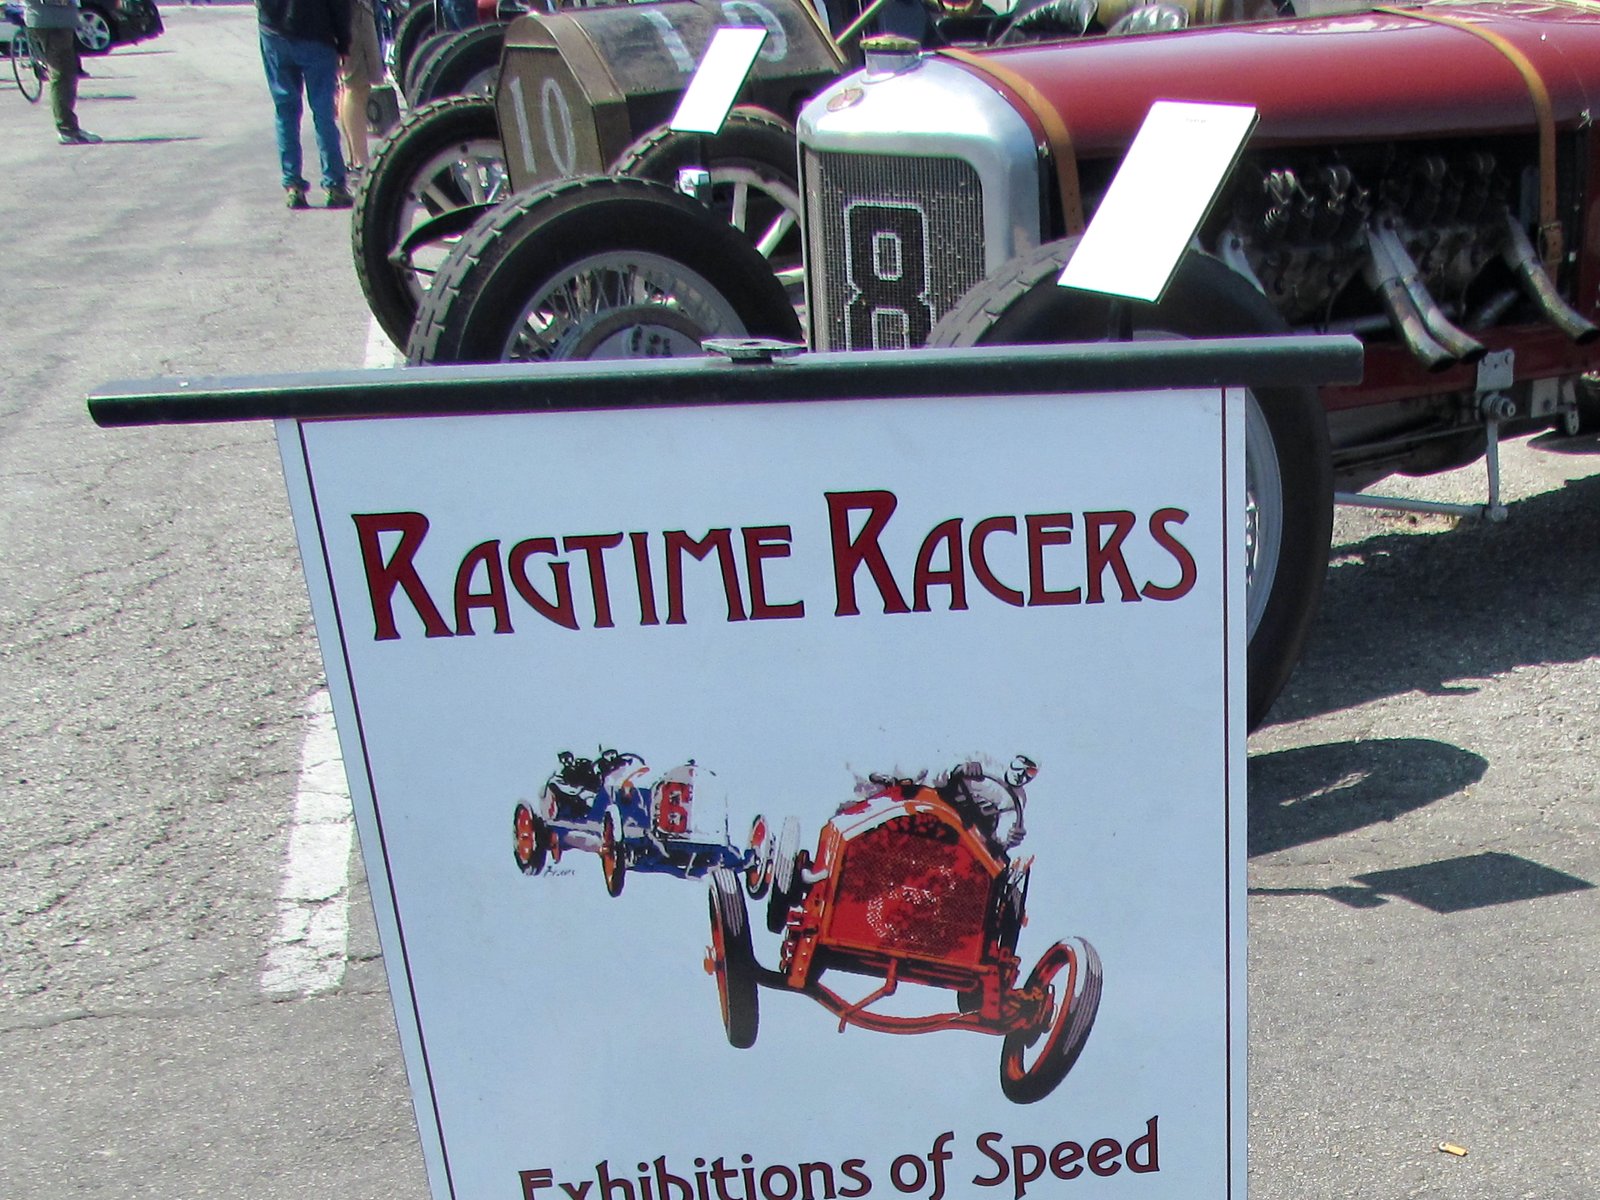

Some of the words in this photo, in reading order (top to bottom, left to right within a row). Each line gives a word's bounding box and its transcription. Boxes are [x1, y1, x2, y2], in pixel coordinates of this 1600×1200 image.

[509, 76, 576, 177] 10
[350, 511, 805, 641] RAGTIME
[824, 490, 1199, 617] RACERS
[972, 1115, 1161, 1200] Speed
